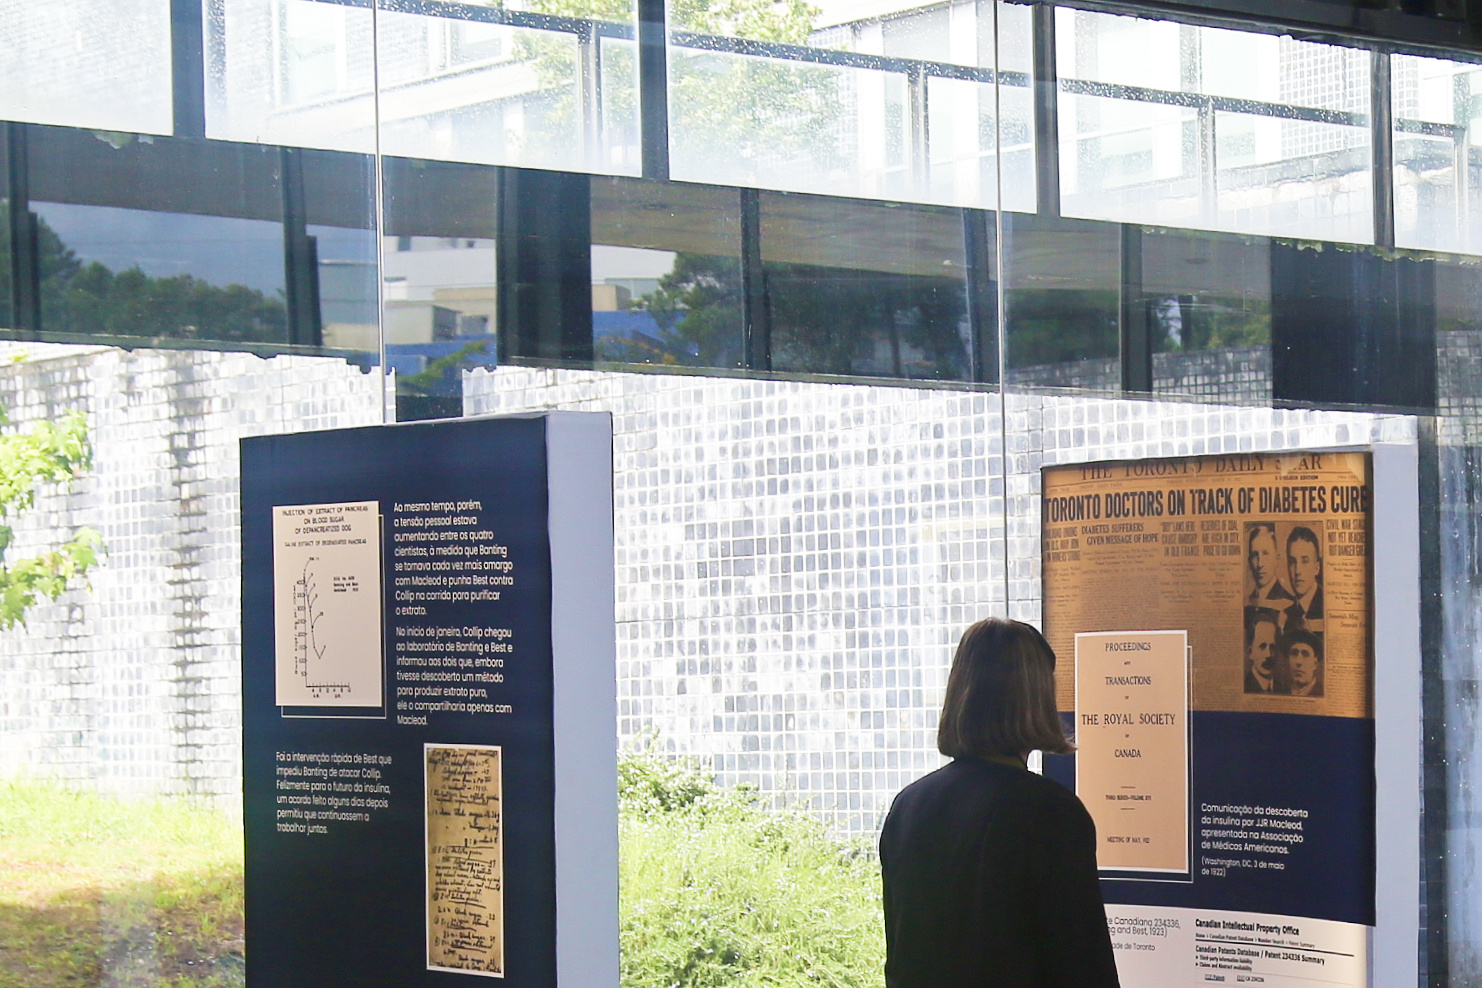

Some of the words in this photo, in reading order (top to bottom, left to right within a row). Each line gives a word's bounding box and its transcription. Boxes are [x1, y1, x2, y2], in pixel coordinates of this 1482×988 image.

[1081, 465, 1112, 481] THE
[1215, 455, 1265, 473] DAILY
[1275, 454, 1323, 471] SAR
[393, 502, 403, 512] Ao
[403, 503, 430, 511] mesmo
[430, 501, 455, 513] tempo,
[456, 500, 482, 512] porém,
[1046, 493, 1100, 524] TORONTO
[1105, 490, 1163, 519] DOCTORS
[1168, 489, 1186, 516] ON
[1189, 487, 1233, 515] TRACK
[1238, 486, 1255, 513] OF
[1258, 485, 1327, 514] DIABETES
[1331, 485, 1367, 513] CURE
[394, 546, 428, 556] cientistas,
[429, 545, 434, 555] à
[435, 545, 463, 555] medida
[464, 546, 478, 557] que
[479, 545, 507, 557] Banting
[1105, 642, 1151, 651] PROCEEDINGS
[1105, 676, 1151, 685] TRANSACTIONS
[397, 715, 428, 725] Macleod.
[1081, 714, 1099, 725] THE
[1104, 713, 1134, 724] ROYAL
[1139, 713, 1175, 725] SOCIETY
[1114, 749, 1141, 757] CANADA
[1201, 803, 1252, 816] Comunicação
[1253, 805, 1264, 814] da
[1265, 807, 1308, 817] descoberta
[1201, 816, 1211, 824] da
[1212, 816, 1240, 825] insulina
[1241, 819, 1254, 828] por
[1255, 818, 1268, 827] JJR
[1269, 819, 1303, 830] Macleod,
[1195, 918, 1221, 928] Canadian
[1222, 921, 1254, 931] Intellectual
[1256, 923, 1280, 934] Property
[1282, 925, 1299, 935] Office
